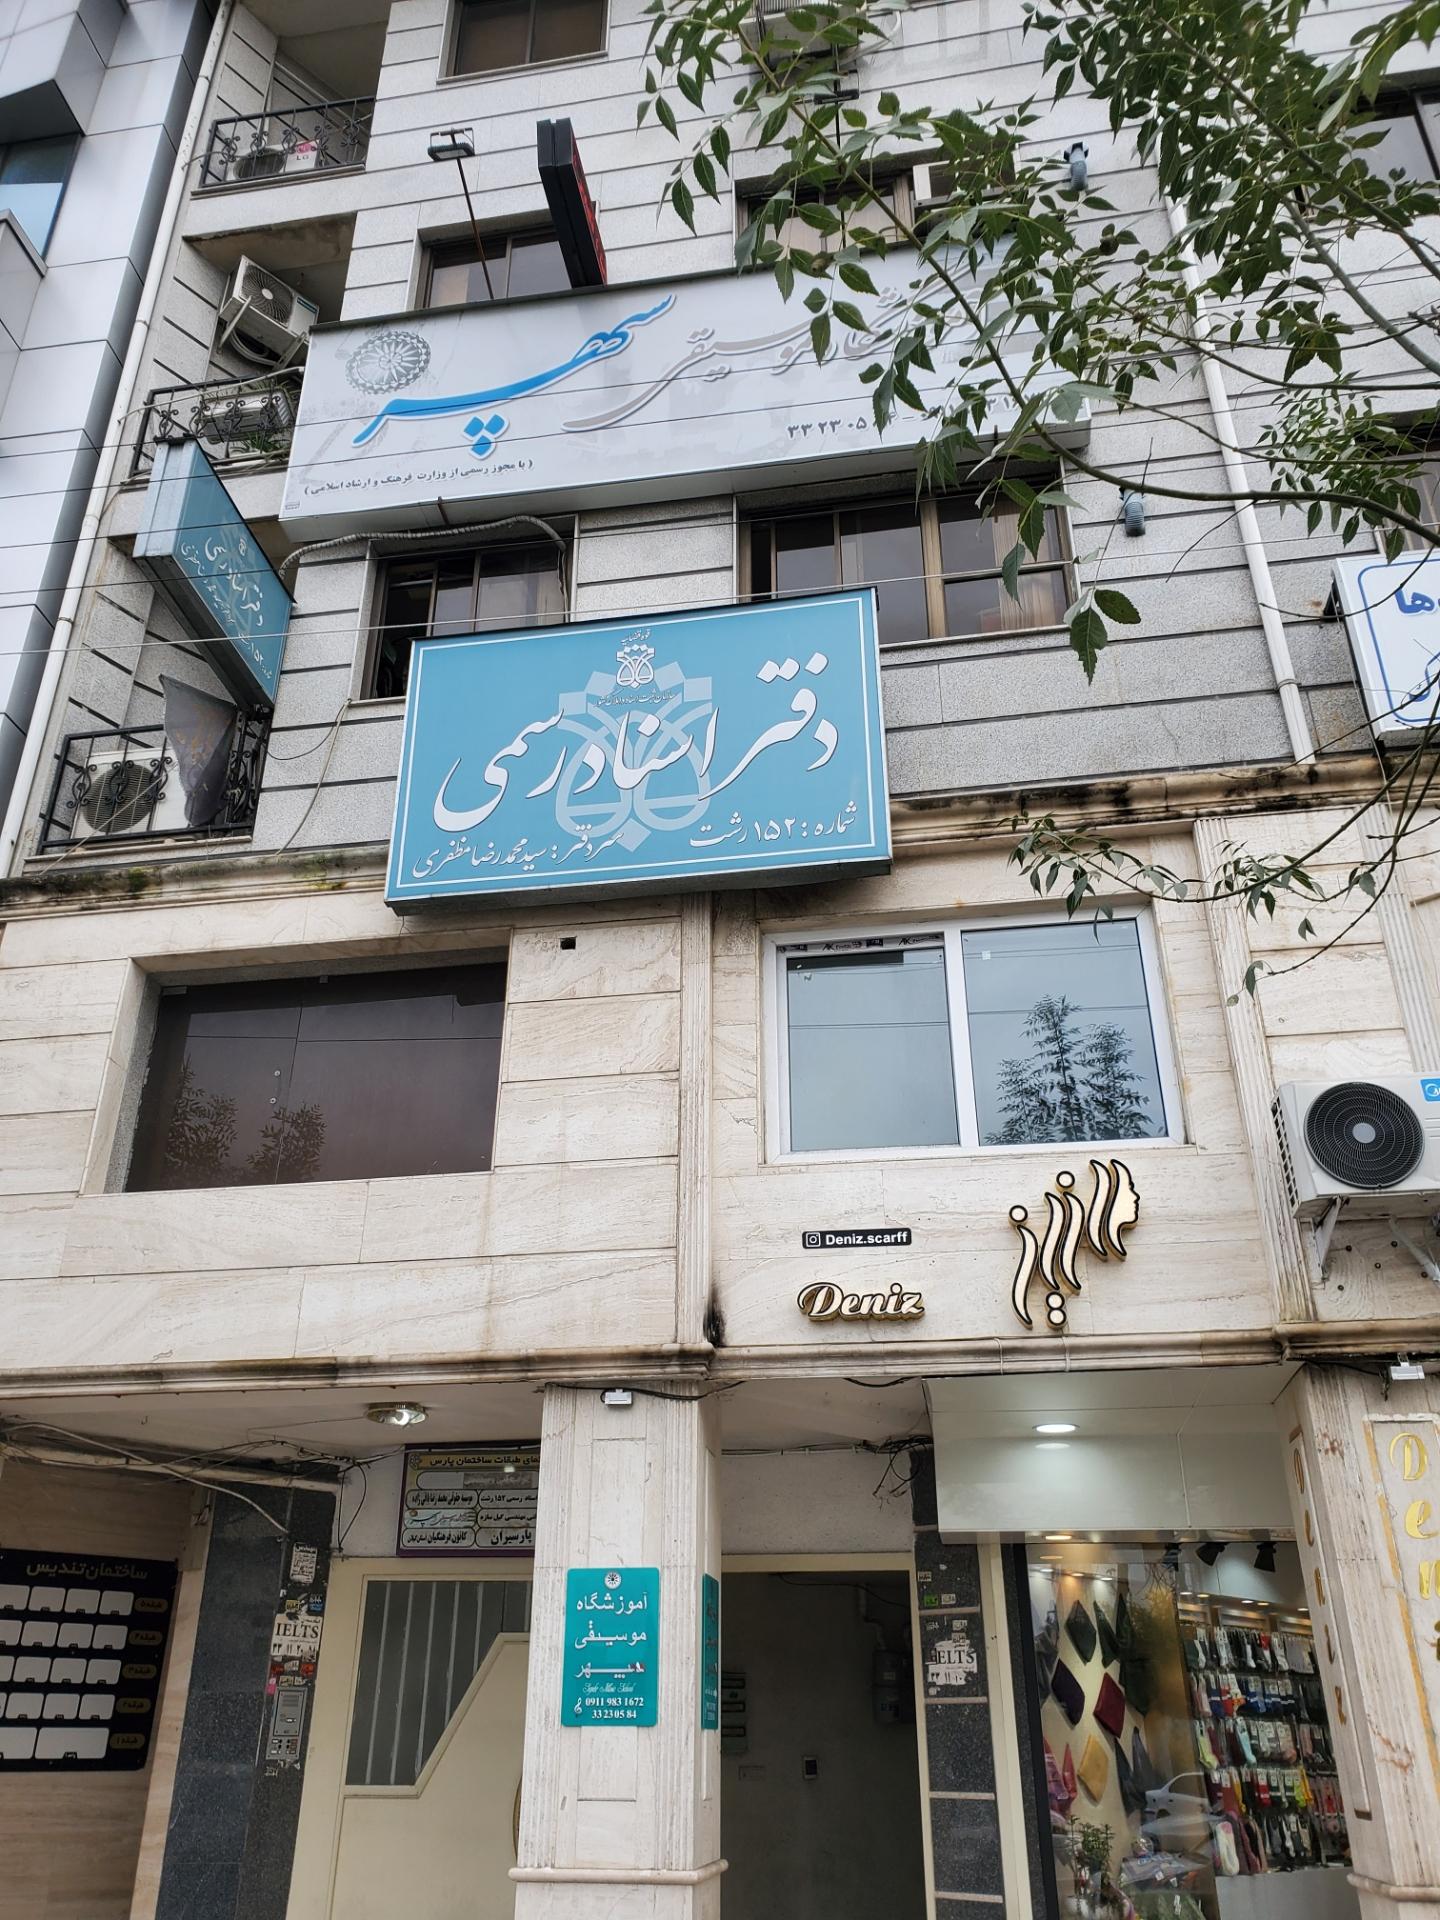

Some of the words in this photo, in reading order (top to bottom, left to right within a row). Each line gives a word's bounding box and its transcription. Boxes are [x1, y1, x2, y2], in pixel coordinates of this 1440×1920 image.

[352, 293, 676, 459] سپهر
[417, 470, 447, 481] وزارت
[449, 467, 459, 478] از
[461, 467, 490, 477] رسمی
[491, 463, 515, 475] مجوز
[345, 478, 371, 489] ارشاد
[239, 584, 264, 627] دفتر
[697, 652, 839, 802] دفتر
[573, 706, 720, 794] اسناد
[432, 707, 569, 833] رسمی
[689, 811, 749, 848] رشت
[753, 816, 797, 842] ۱۵۲
[411, 836, 472, 879] مظفری
[825, 1231, 908, 1247] Deniz.scarff
[797, 1282, 925, 1321] Deniz
[430, 1456, 455, 1467] پارس
[456, 1456, 492, 1466] ساختمان
[494, 1455, 521, 1464] طبقات
[490, 1529, 532, 1546] پارسیران
[26, 1560, 87, 1577] تندیس
[85, 1562, 148, 1580] ساختمان
[576, 1591, 648, 1615] آموزشگاه
[276, 1622, 319, 1639] IELTS
[574, 1620, 647, 1650] موسیقی
[936, 1650, 975, 1665] ELTS
[586, 1697, 605, 1707] 0911
[606, 1697, 622, 1707] 983
[624, 1697, 645, 1707] 1672
